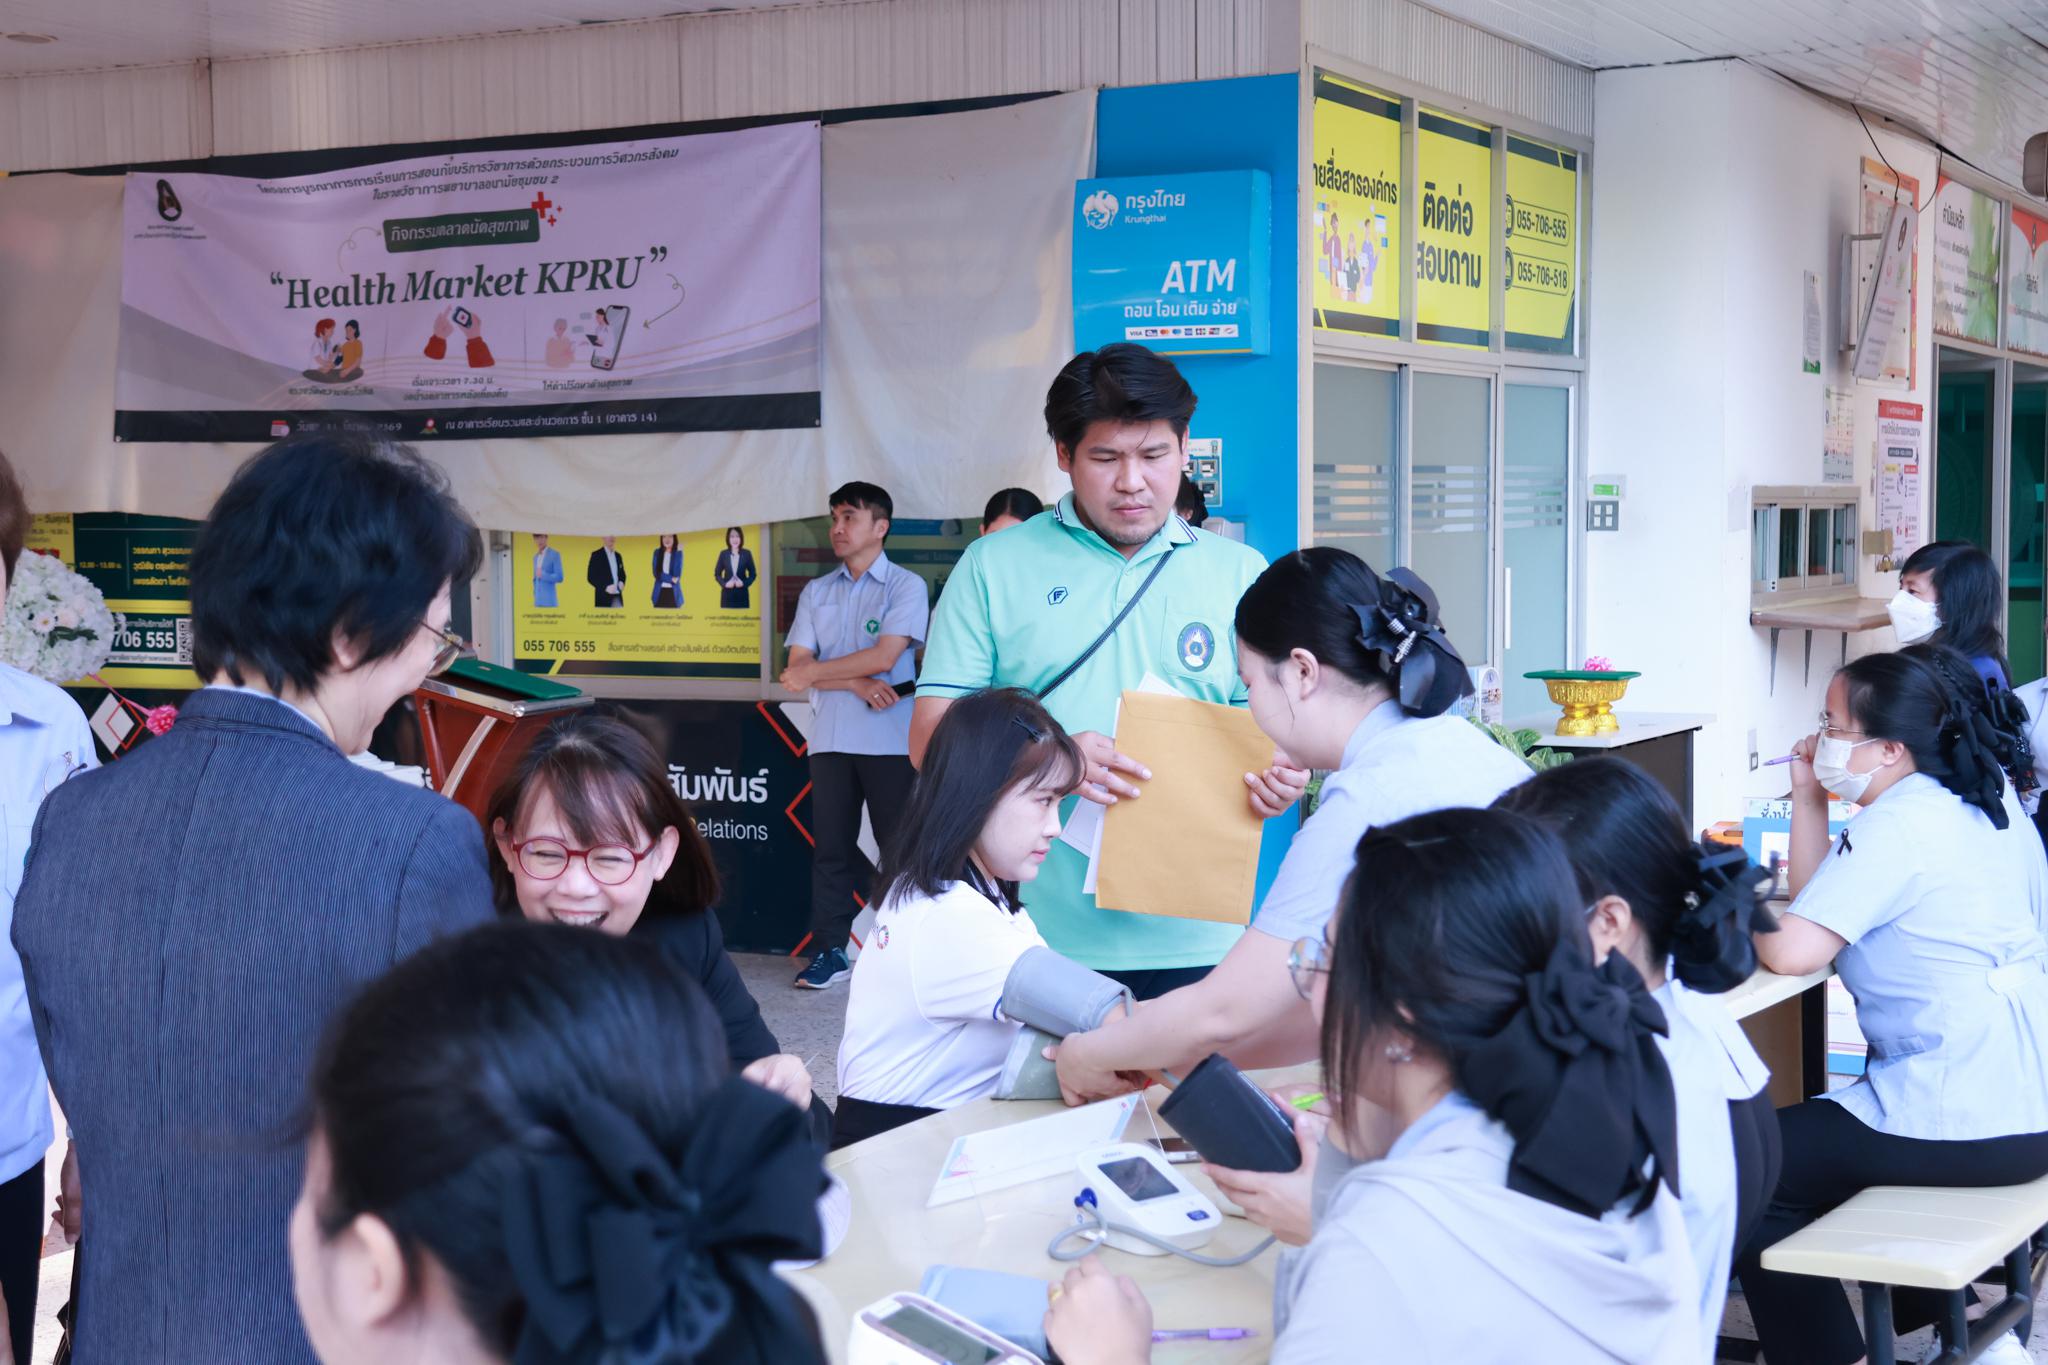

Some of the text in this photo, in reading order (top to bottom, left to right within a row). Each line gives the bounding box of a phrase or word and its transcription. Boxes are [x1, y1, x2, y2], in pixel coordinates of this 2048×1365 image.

[551, 175, 559, 184] 2
[1125, 189, 1186, 214] กรุงไทย
[1423, 181, 1474, 237] ติดต่อ
[390, 219, 530, 242] กิจกรรมตลาดนัดสุขภาพ
[1125, 214, 1167, 225] Krungthai
[1516, 209, 1567, 240] 055-706-555
[401, 264, 527, 303] Market
[1161, 258, 1236, 294] ATM
[1517, 261, 1568, 289] 055-706-518
[1124, 298, 1236, 318] ถอน โอน เติม จ่าย
[113, 631, 175, 649] 706 555
[523, 640, 544, 652] 055
[549, 640, 570, 652] 706
[574, 641, 595, 653] 555
[689, 816, 768, 841] elations
